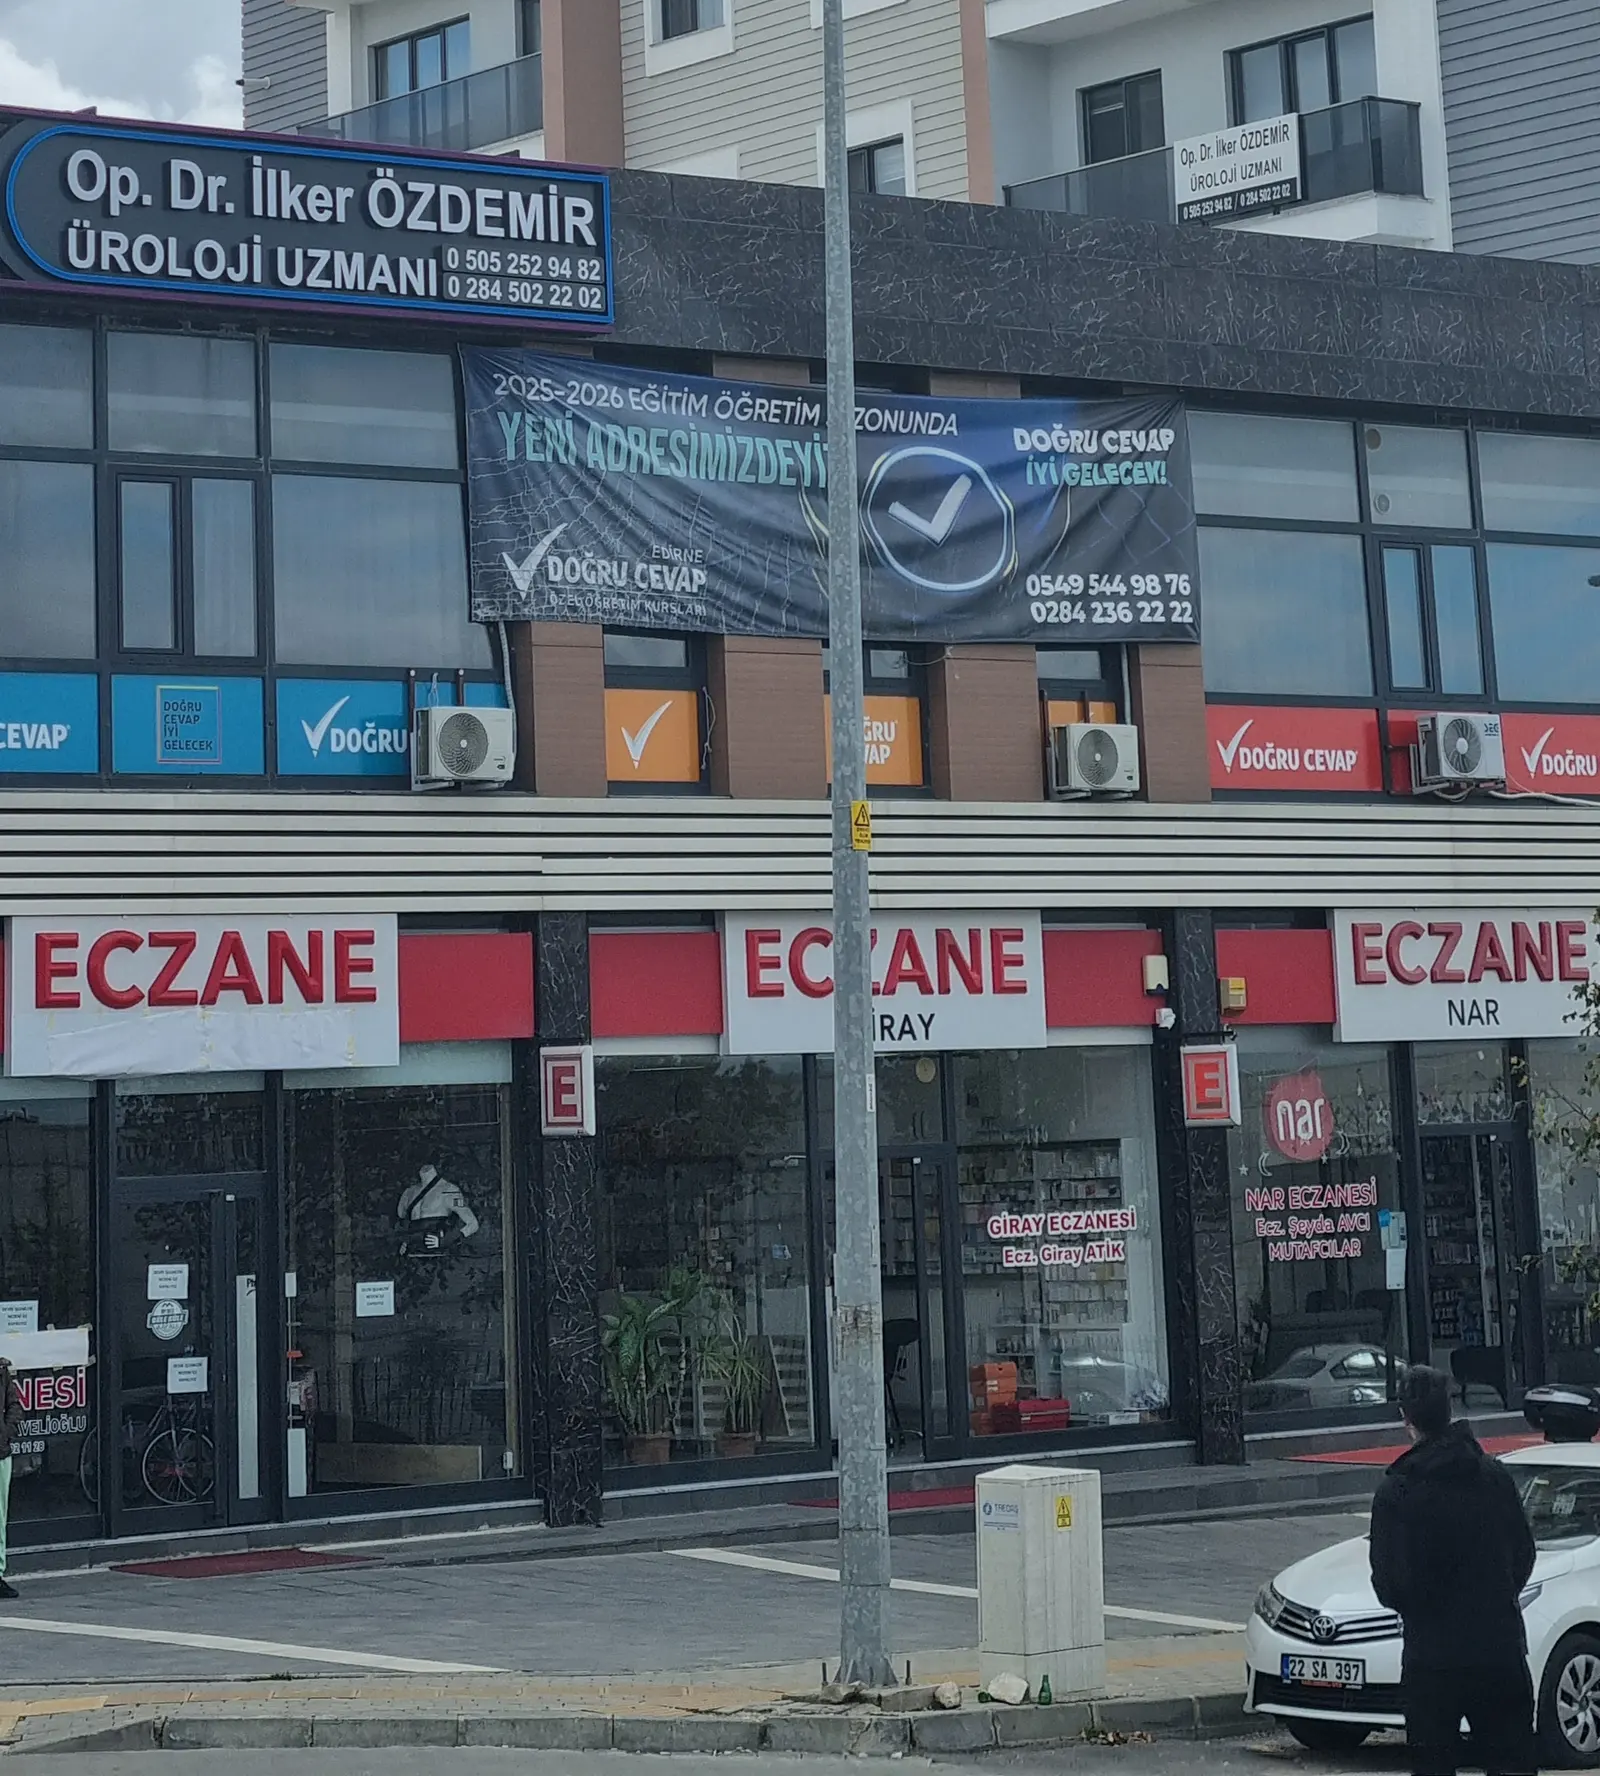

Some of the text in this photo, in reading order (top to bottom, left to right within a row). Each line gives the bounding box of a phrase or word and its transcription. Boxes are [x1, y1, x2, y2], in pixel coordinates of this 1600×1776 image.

[1180, 120, 1290, 168] Op. Dr. İlker ÖZDEMİR
[1190, 157, 1282, 191] ÜROLOJİ UZMANI
[66, 149, 598, 246] Op. Dr. İlker ÖZDEMİR
[1183, 209, 1187, 219] 0
[1189, 204, 1200, 218] 505
[1202, 202, 1213, 216] 252
[1215, 200, 1223, 212] 94
[1224, 198, 1232, 210] 82
[1240, 194, 1245, 205] 0
[1247, 191, 1258, 204] 284
[1260, 188, 1271, 201] 502
[1272, 186, 1280, 197] 22
[1282, 184, 1290, 196] 02
[68, 219, 438, 296] ÜROLOJİ UZMANI
[447, 248, 600, 281] 0 505 252 94 82
[448, 276, 602, 310] 0 284 502 22 02
[493, 373, 958, 436] 2025-2026 EĞİTİM ÖĞRETİM ZONUNDA
[497, 410, 828, 489] YENİ ADRESİMİZDEYİ
[1013, 423, 1175, 454] DOĞRU CEVAP
[1026, 454, 1167, 487] İYİ GELECEK!
[652, 544, 703, 563] EDİRNE
[548, 551, 706, 593] DOĞRU CEVAP
[1026, 574, 1190, 597] 0549 544 98 76
[645, 600, 707, 616] KURSLARI
[1030, 601, 1193, 623] 0284 236 22 22
[164, 699, 202, 712] DOĞRU
[164, 714, 200, 724] CEVAP
[164, 724, 178, 737] İYİ
[164, 740, 213, 751] GELECEK
[331, 721, 407, 753] DOĞRU
[864, 716, 895, 742] ĞRU
[1239, 742, 1356, 772] DOĞRU CEVAP
[1542, 749, 1597, 776] DOĞRU
[35, 929, 377, 1009] ECZANE
[745, 927, 1028, 998] ECANE
[1351, 920, 1590, 985] ECZANE
[872, 1007, 935, 1041] İRAY
[1447, 999, 1500, 1026] NAR
[552, 1065, 577, 1117] E
[1194, 1062, 1220, 1109] E
[1276, 1096, 1325, 1142] nar
[1245, 1176, 1377, 1211] NAR ECZANESİ
[988, 1206, 1137, 1238] GİRAY ECZANESİ
[1255, 1213, 1370, 1239] Ecz. Şeyda AVCI
[1003, 1238, 1125, 1267] Ecz. Giray ATİK
[13, 1366, 86, 1411] NESİ
[18, 1413, 86, 1436] VELİOĞLU
[1290, 1659, 1305, 1677] 22
[1312, 1661, 1327, 1679] SA
[1335, 1663, 1360, 1681] 397
